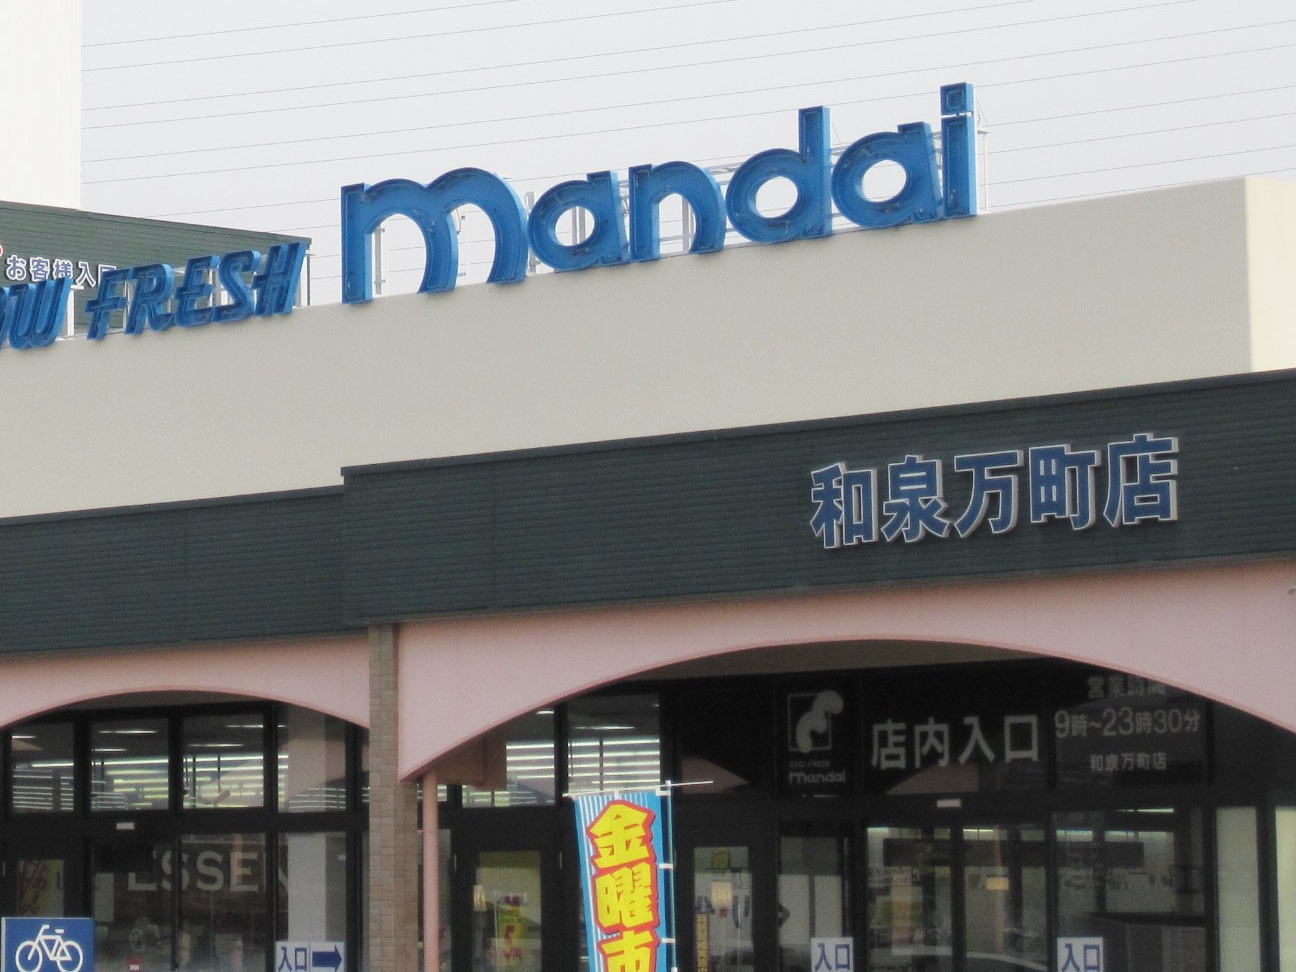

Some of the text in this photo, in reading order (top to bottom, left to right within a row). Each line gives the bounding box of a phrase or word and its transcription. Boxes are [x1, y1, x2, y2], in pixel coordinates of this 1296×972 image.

[341, 82, 977, 304] mandai
[85, 242, 309, 340] FRESH
[810, 433, 1177, 549] 和泉万町店
[870, 715, 1038, 770] 店内入口
[1090, 752, 1167, 771] 和泉万町店
[586, 799, 660, 972] 金曜市
[278, 946, 307, 972] 入口
[814, 943, 850, 971] 入口
[1061, 943, 1100, 972] 入口
